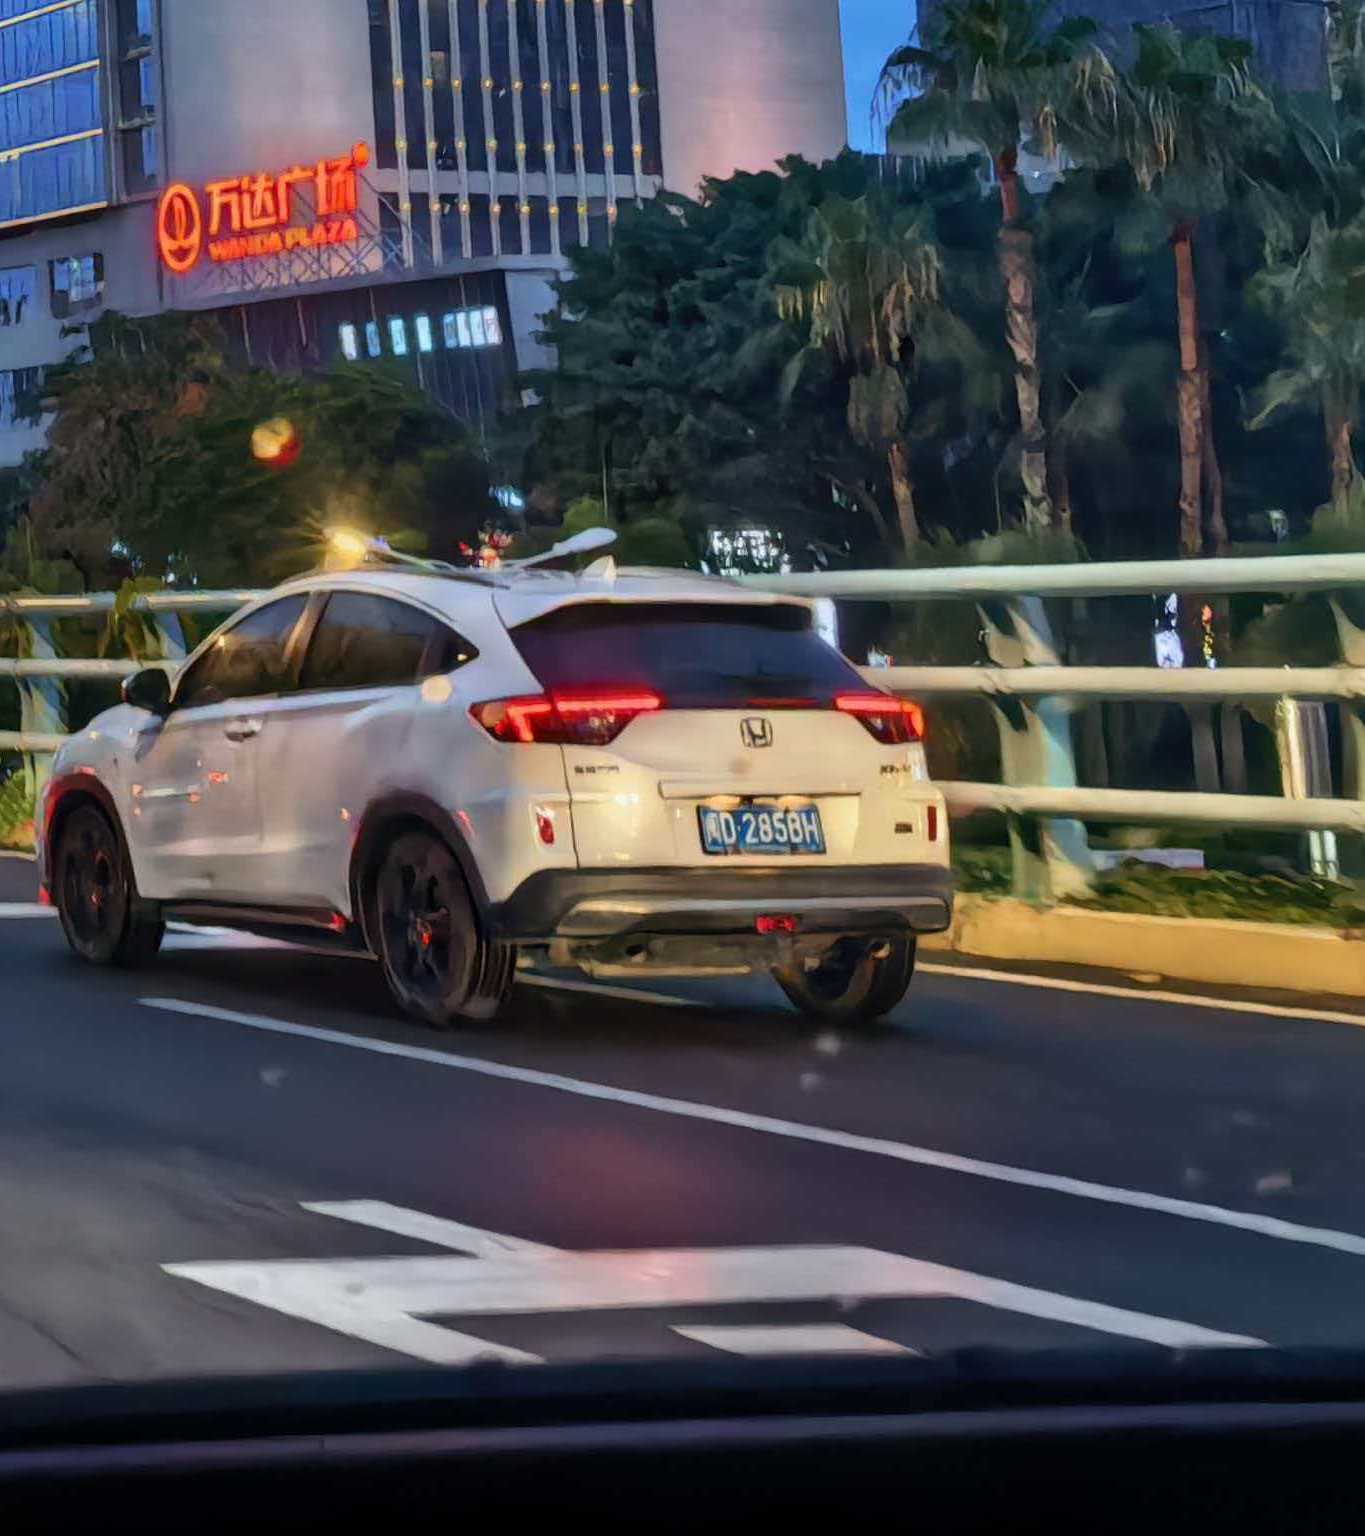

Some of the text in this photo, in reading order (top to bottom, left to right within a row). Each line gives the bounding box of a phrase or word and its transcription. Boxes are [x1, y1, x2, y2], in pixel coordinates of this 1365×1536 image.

[205, 157, 356, 234] 万达广场
[207, 218, 357, 262] WANDA PLAZA
